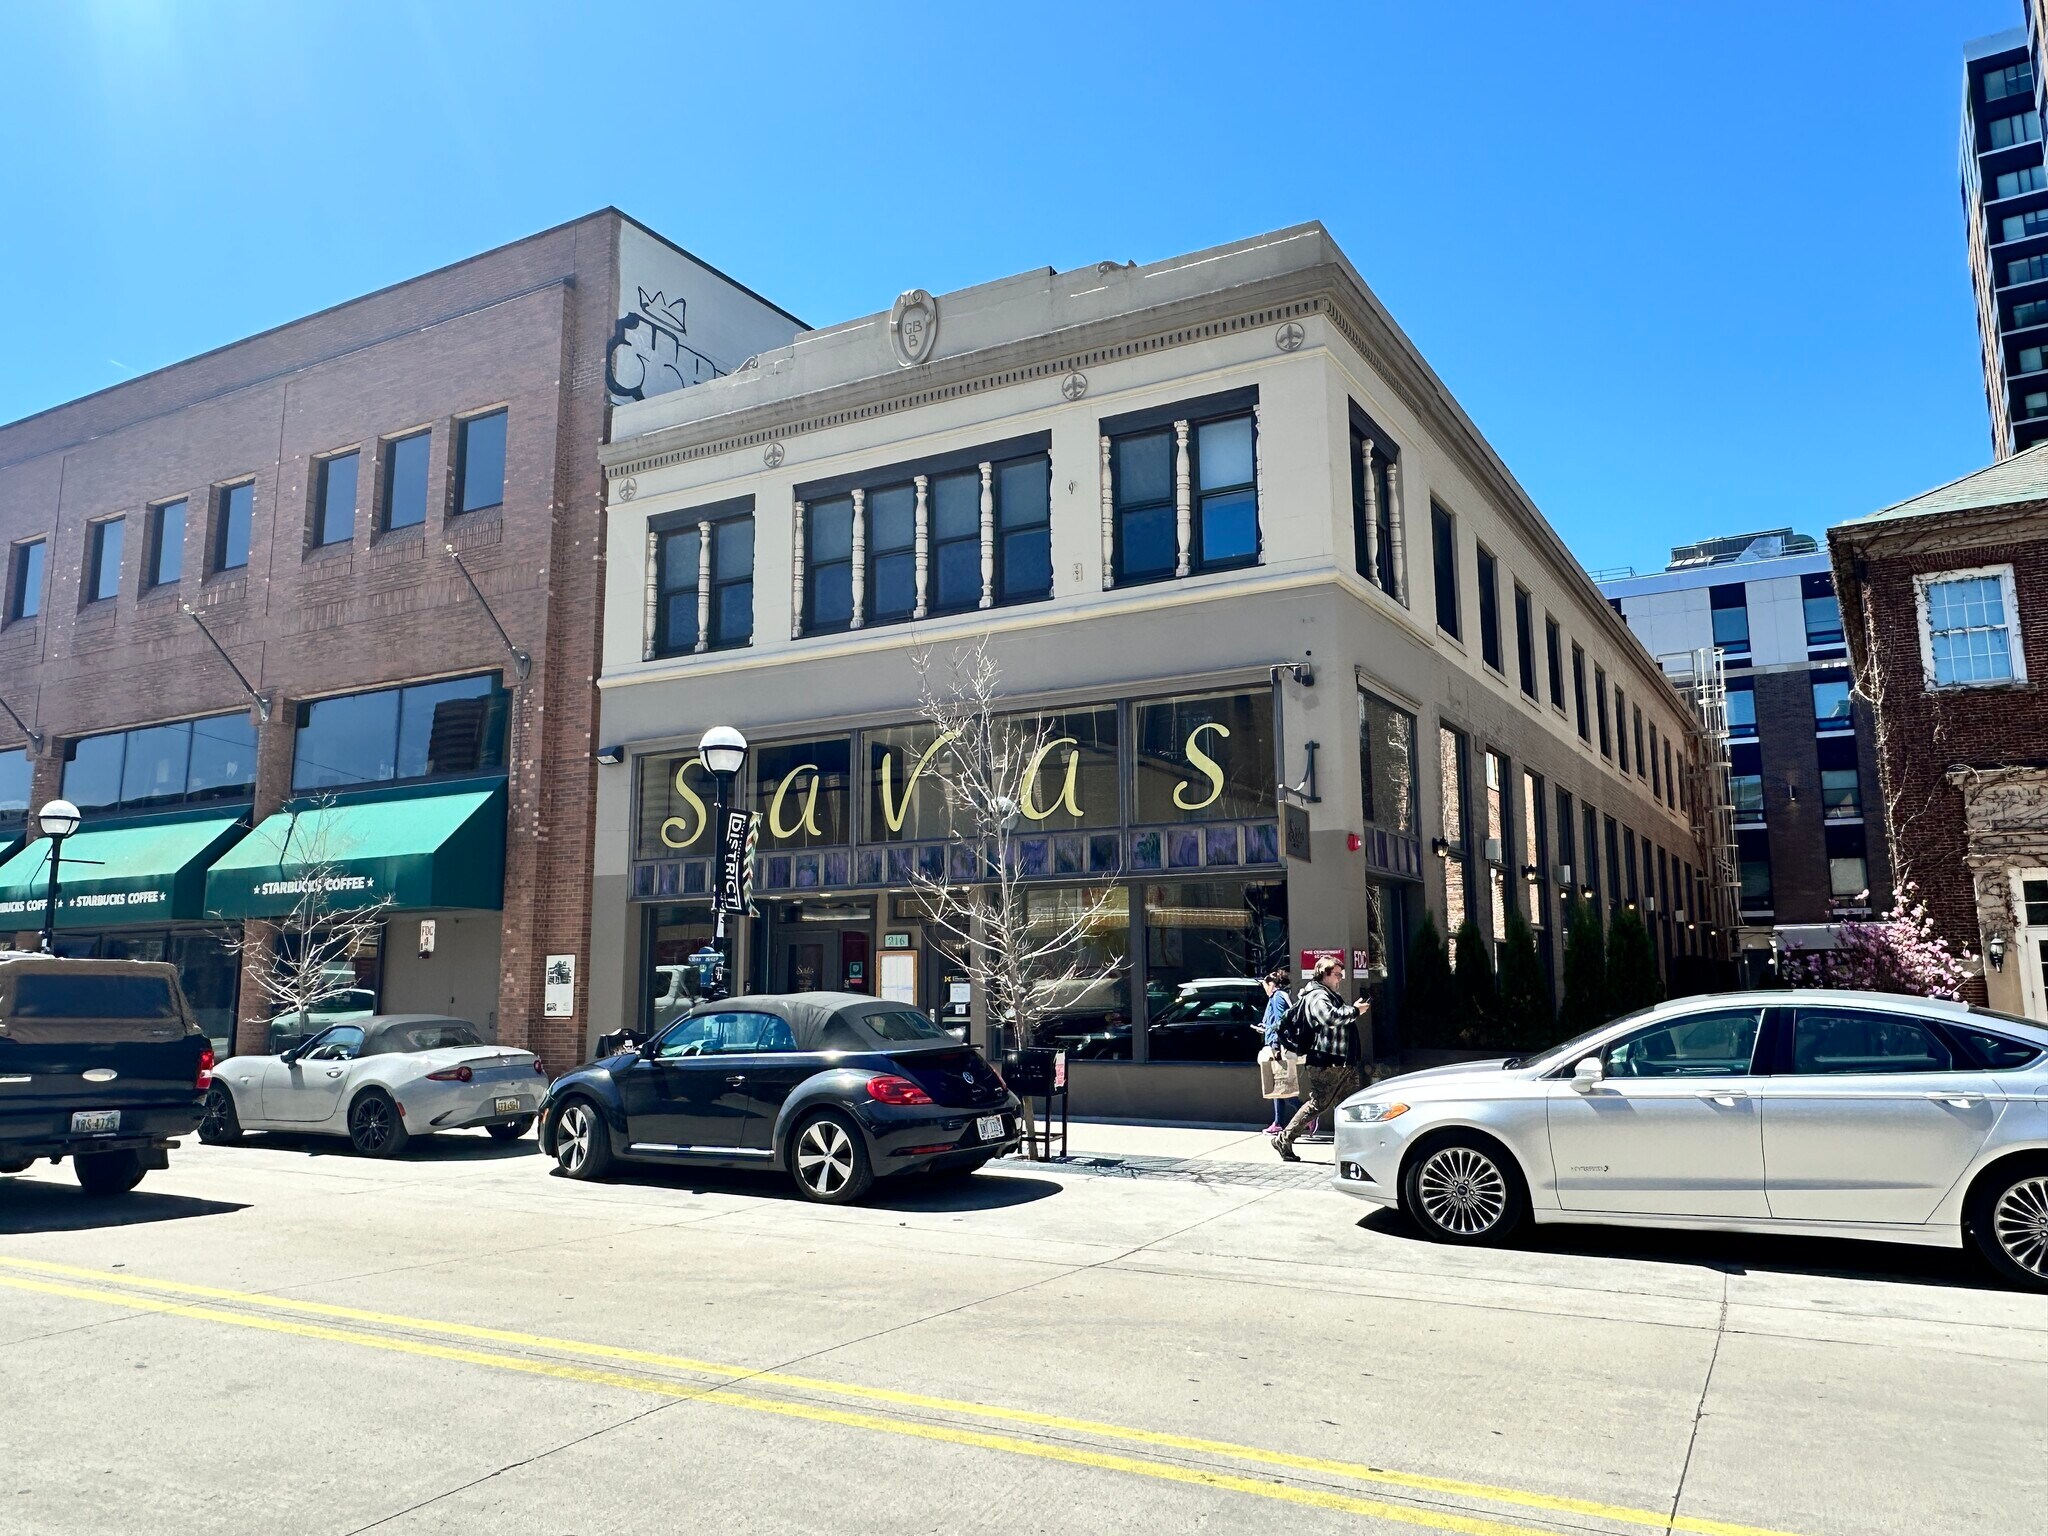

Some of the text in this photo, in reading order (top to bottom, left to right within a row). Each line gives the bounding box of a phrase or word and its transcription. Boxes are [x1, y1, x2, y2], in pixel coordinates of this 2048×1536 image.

[904, 320, 923, 335] GB
[908, 335, 918, 348] B
[725, 818, 743, 907] DISTRICT
[261, 876, 366, 895] STARBUCKS COFFEE
[27, 898, 58, 912] COFF
[76, 891, 159, 907] STARBUCKS COFFEE
[888, 935, 905, 946] 216
[1353, 950, 1368, 969] FDC
